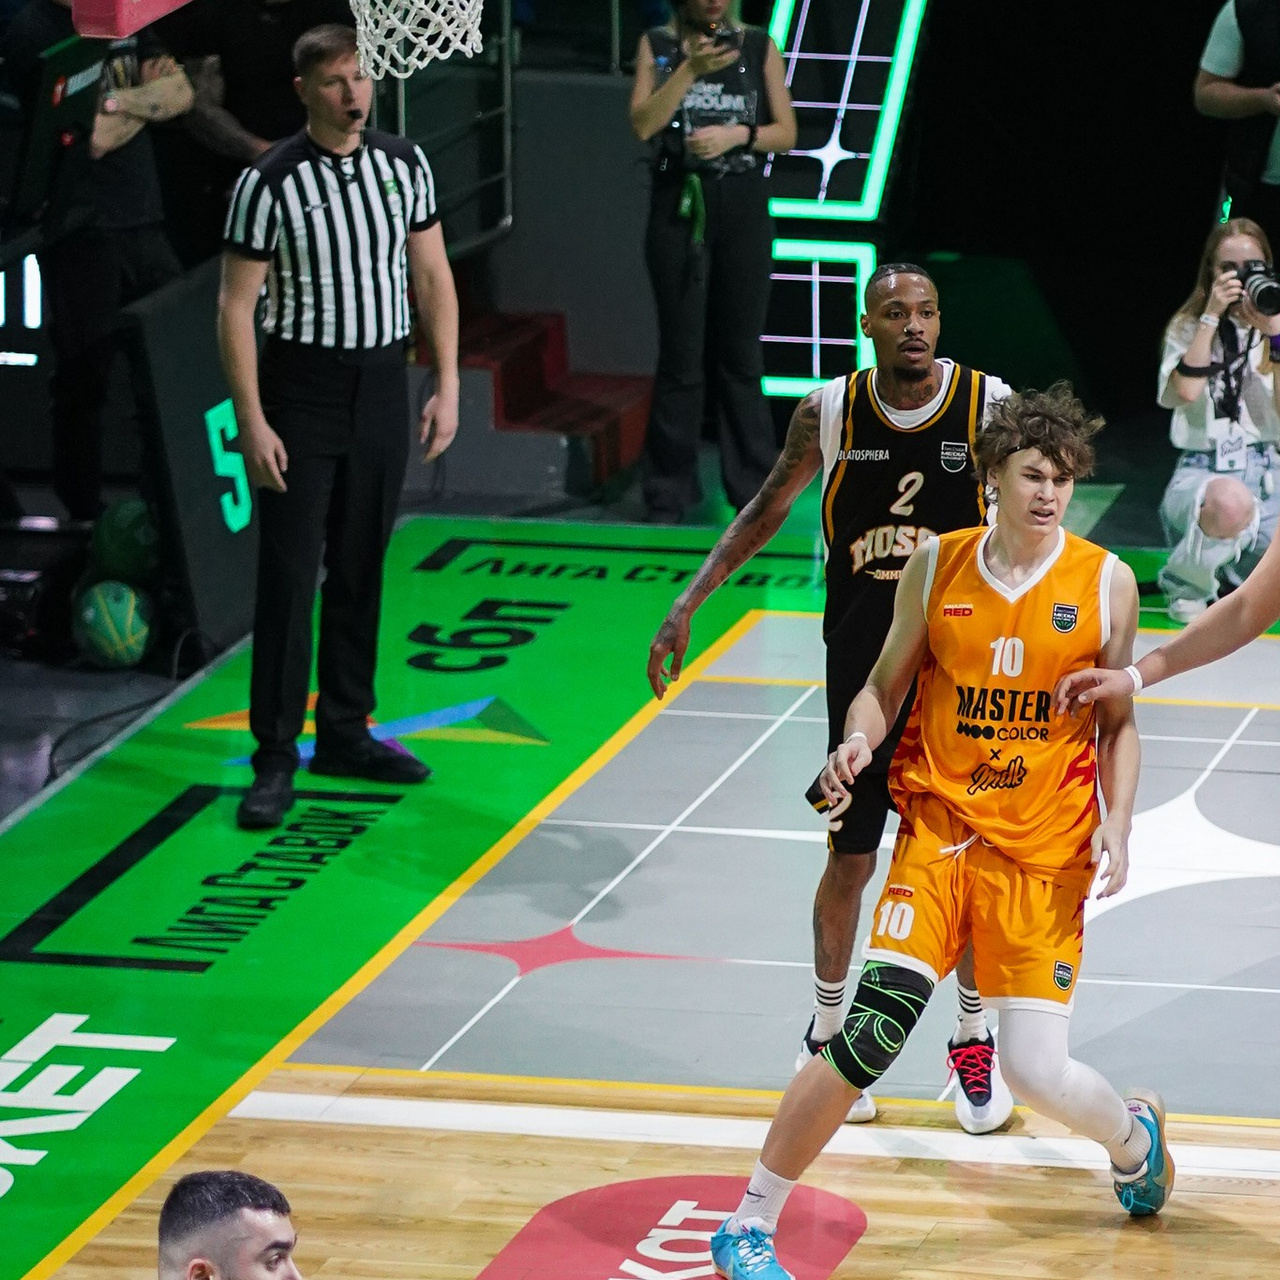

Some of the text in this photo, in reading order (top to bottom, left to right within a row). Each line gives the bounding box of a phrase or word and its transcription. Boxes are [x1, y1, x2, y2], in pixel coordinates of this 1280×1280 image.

[838, 449, 890, 461] BLATOSPHERA
[889, 471, 925, 516] 2
[943, 608, 973, 617] RED
[989, 636, 1025, 678] 10
[956, 685, 1051, 723] MASTER
[997, 726, 1049, 741] COLOR
[888, 887, 914, 898] RED
[876, 901, 915, 940] 10
[0, 1012, 177, 1199] KET
